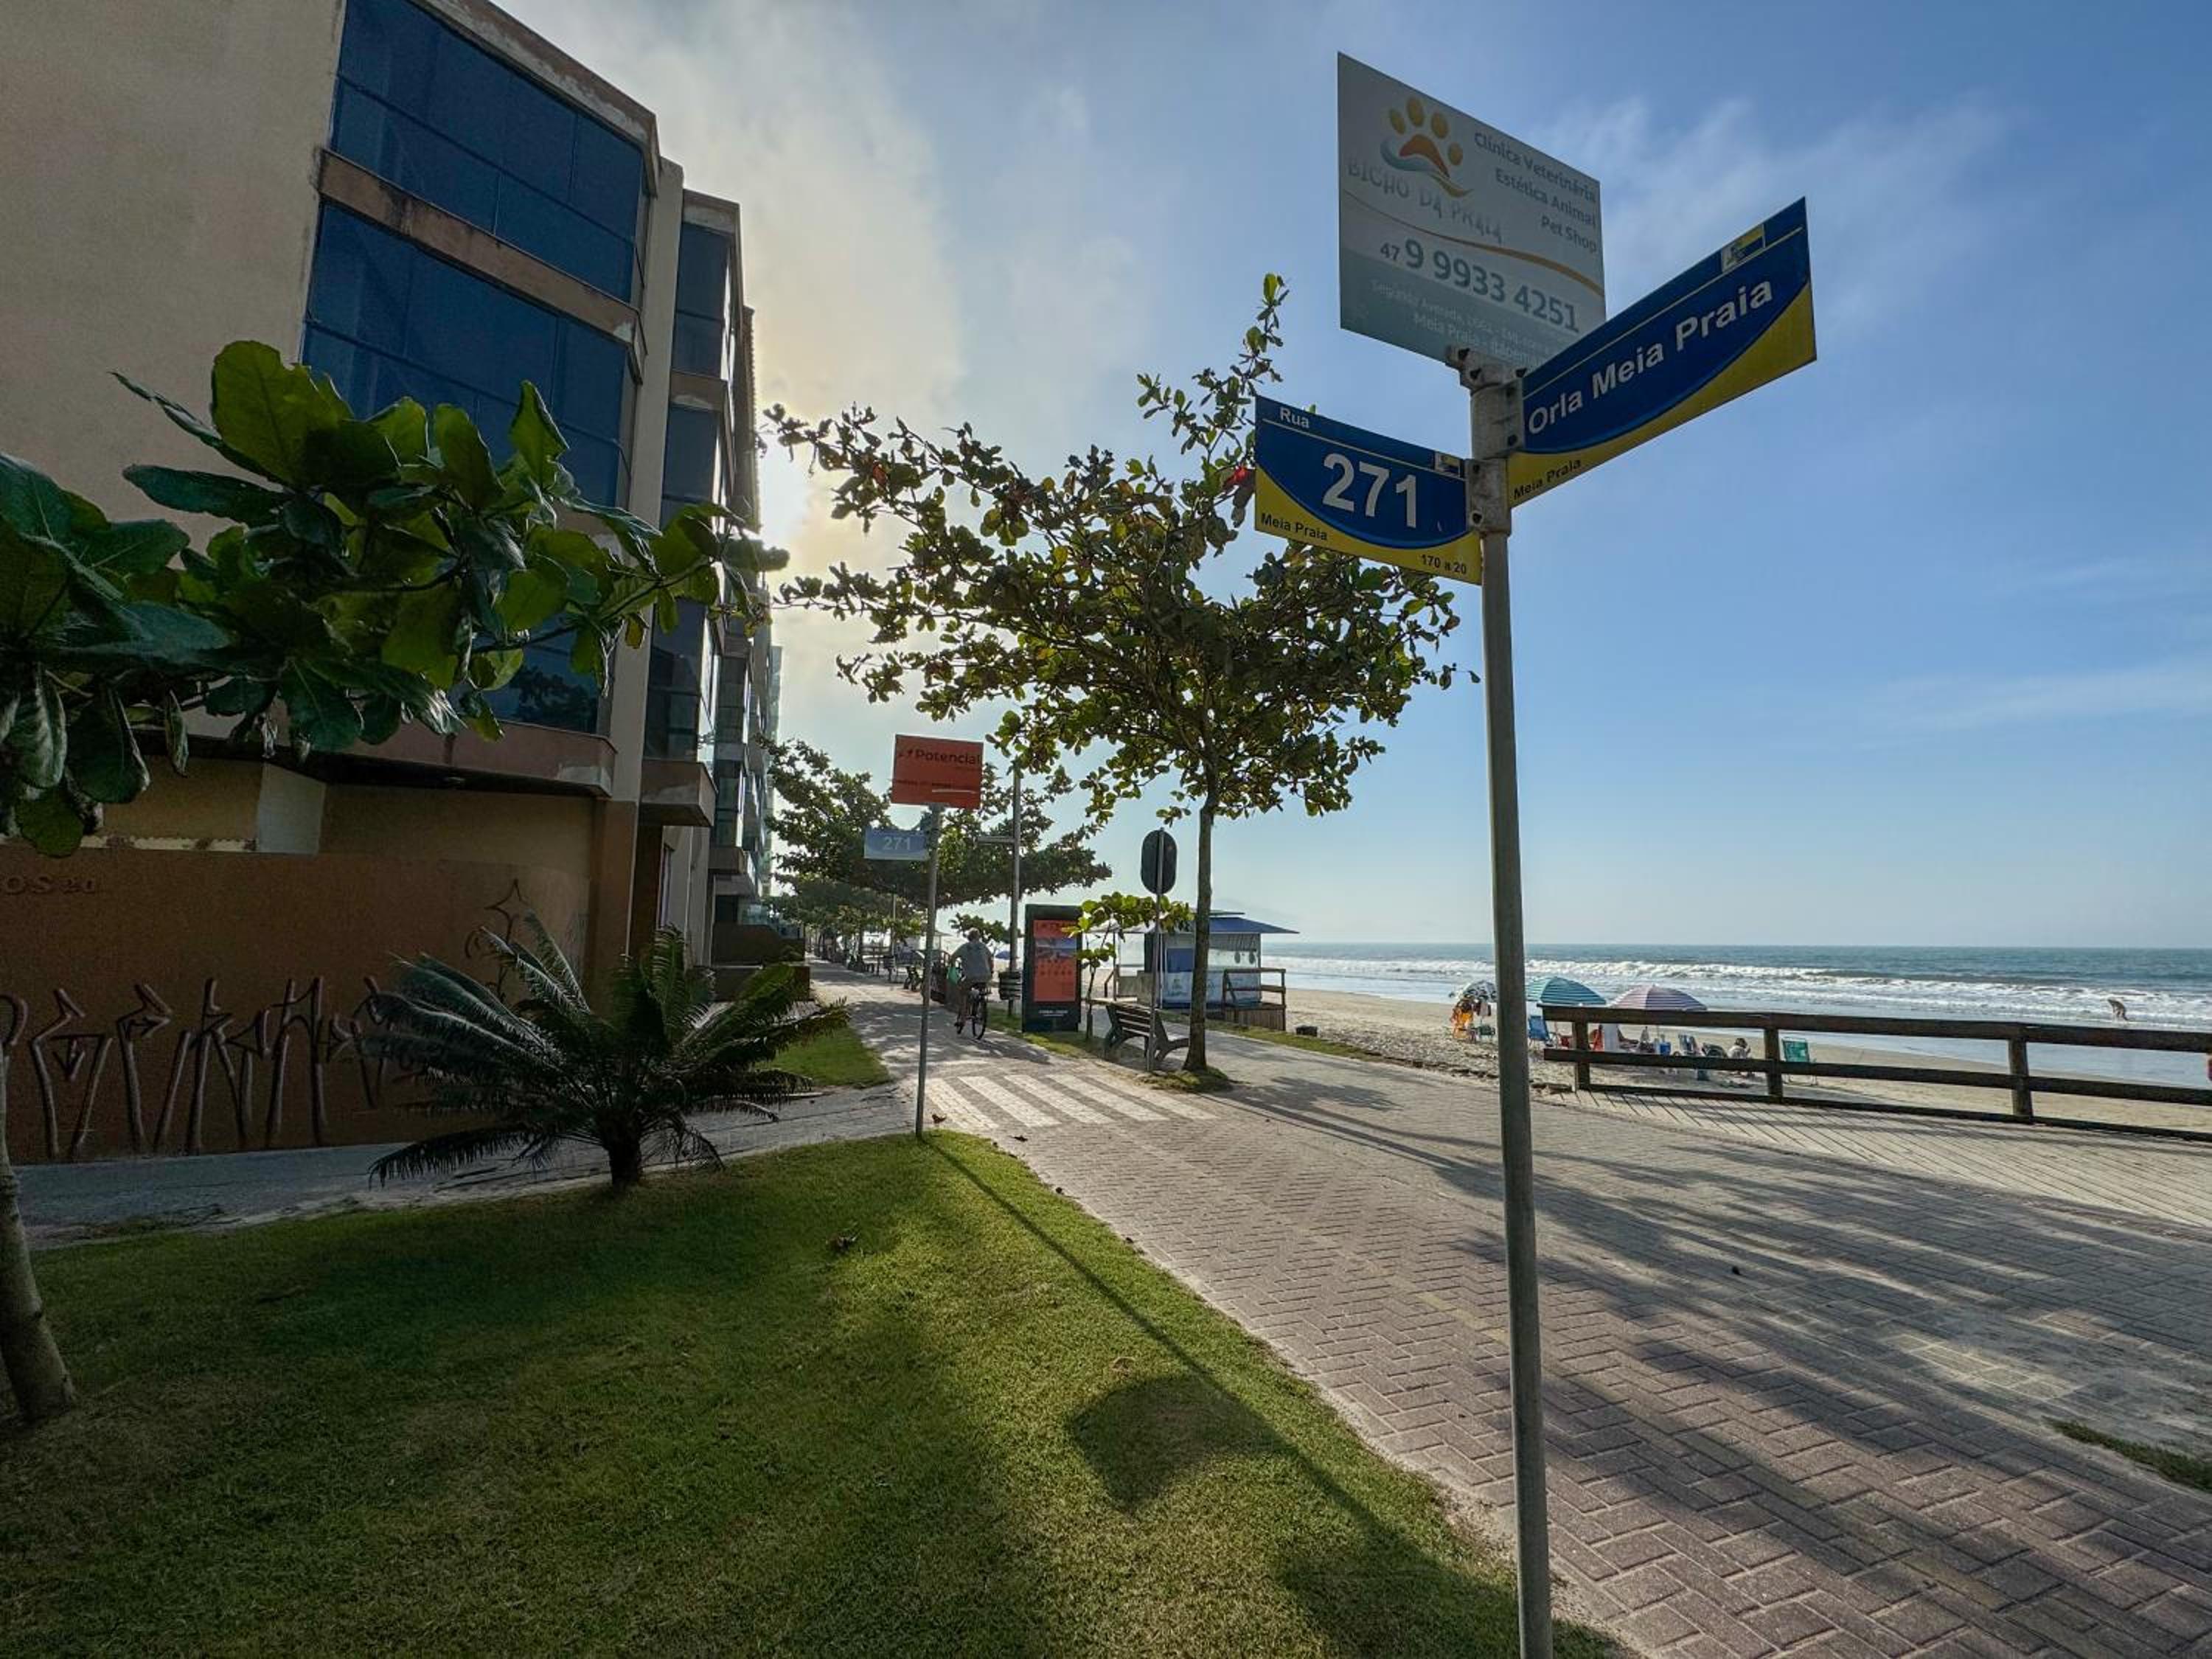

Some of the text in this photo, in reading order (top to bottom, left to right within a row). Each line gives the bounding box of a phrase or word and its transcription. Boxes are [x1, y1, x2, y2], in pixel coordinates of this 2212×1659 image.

[1348, 158, 1409, 198] BICHO
[1495, 167, 1596, 229] Estética Animal
[1542, 215, 1597, 253] Pet Shop
[1380, 242, 1400, 260] 47
[1405, 238, 1424, 269] 9
[1433, 250, 1506, 302] 9933
[1514, 285, 1579, 333] 4251
[1528, 390, 1584, 434] Orla
[1591, 343, 1663, 400] Meia
[1675, 279, 1773, 352] Praia
[1280, 406, 1310, 428] Rua
[1322, 452, 1416, 529] 271
[1513, 457, 1582, 501] Meia Praia
[1260, 513, 1328, 541] Meia Praia
[1421, 554, 1441, 568] 170
[1453, 563, 1467, 575] 20
[915, 748, 981, 765] Potencial
[884, 836, 911, 851] 271
